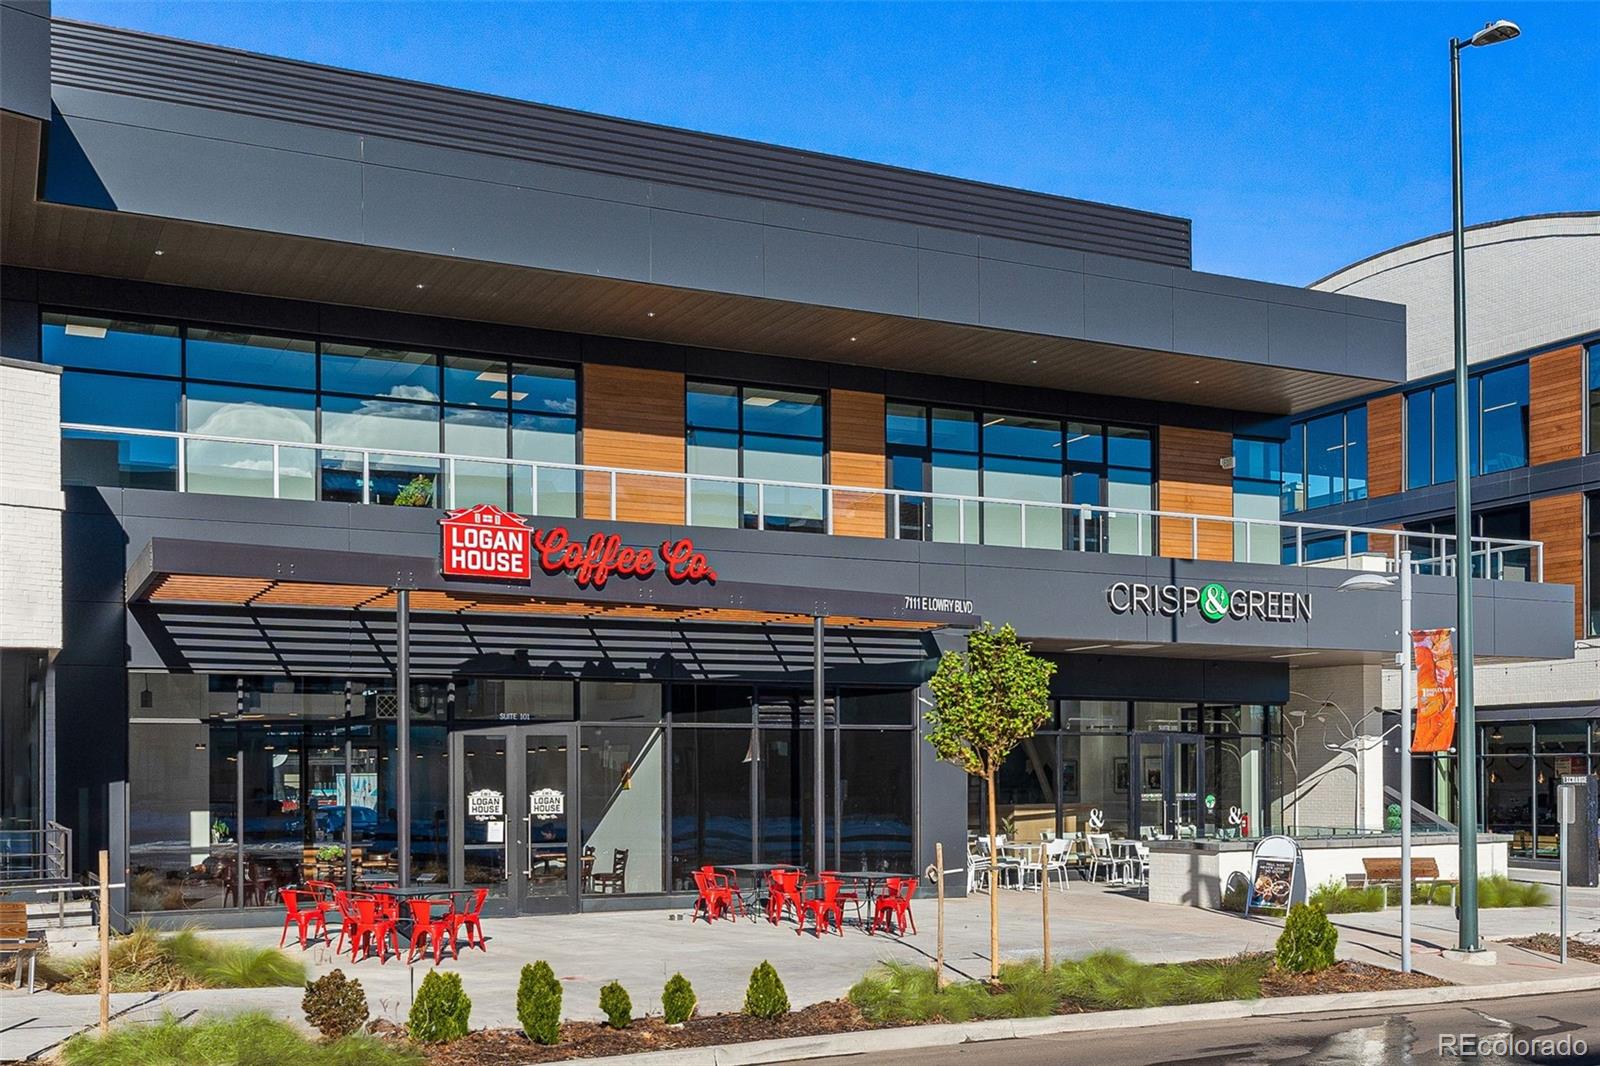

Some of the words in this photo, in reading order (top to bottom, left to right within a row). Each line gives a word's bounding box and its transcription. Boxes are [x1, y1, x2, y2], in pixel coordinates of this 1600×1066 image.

[452, 527, 523, 551] LOGAN
[534, 527, 656, 585] Coffee
[452, 549, 524, 574] HOUSE
[904, 596, 920, 610] 7111
[922, 597, 928, 611] E
[928, 598, 954, 612] LOWRY
[954, 600, 973, 614] BLVD
[499, 712, 518, 721] SUITE
[471, 798, 500, 806] LOGAN
[533, 797, 561, 805] LOGAN
[471, 805, 500, 813] HOUSE
[533, 804, 561, 812] HOUSE
